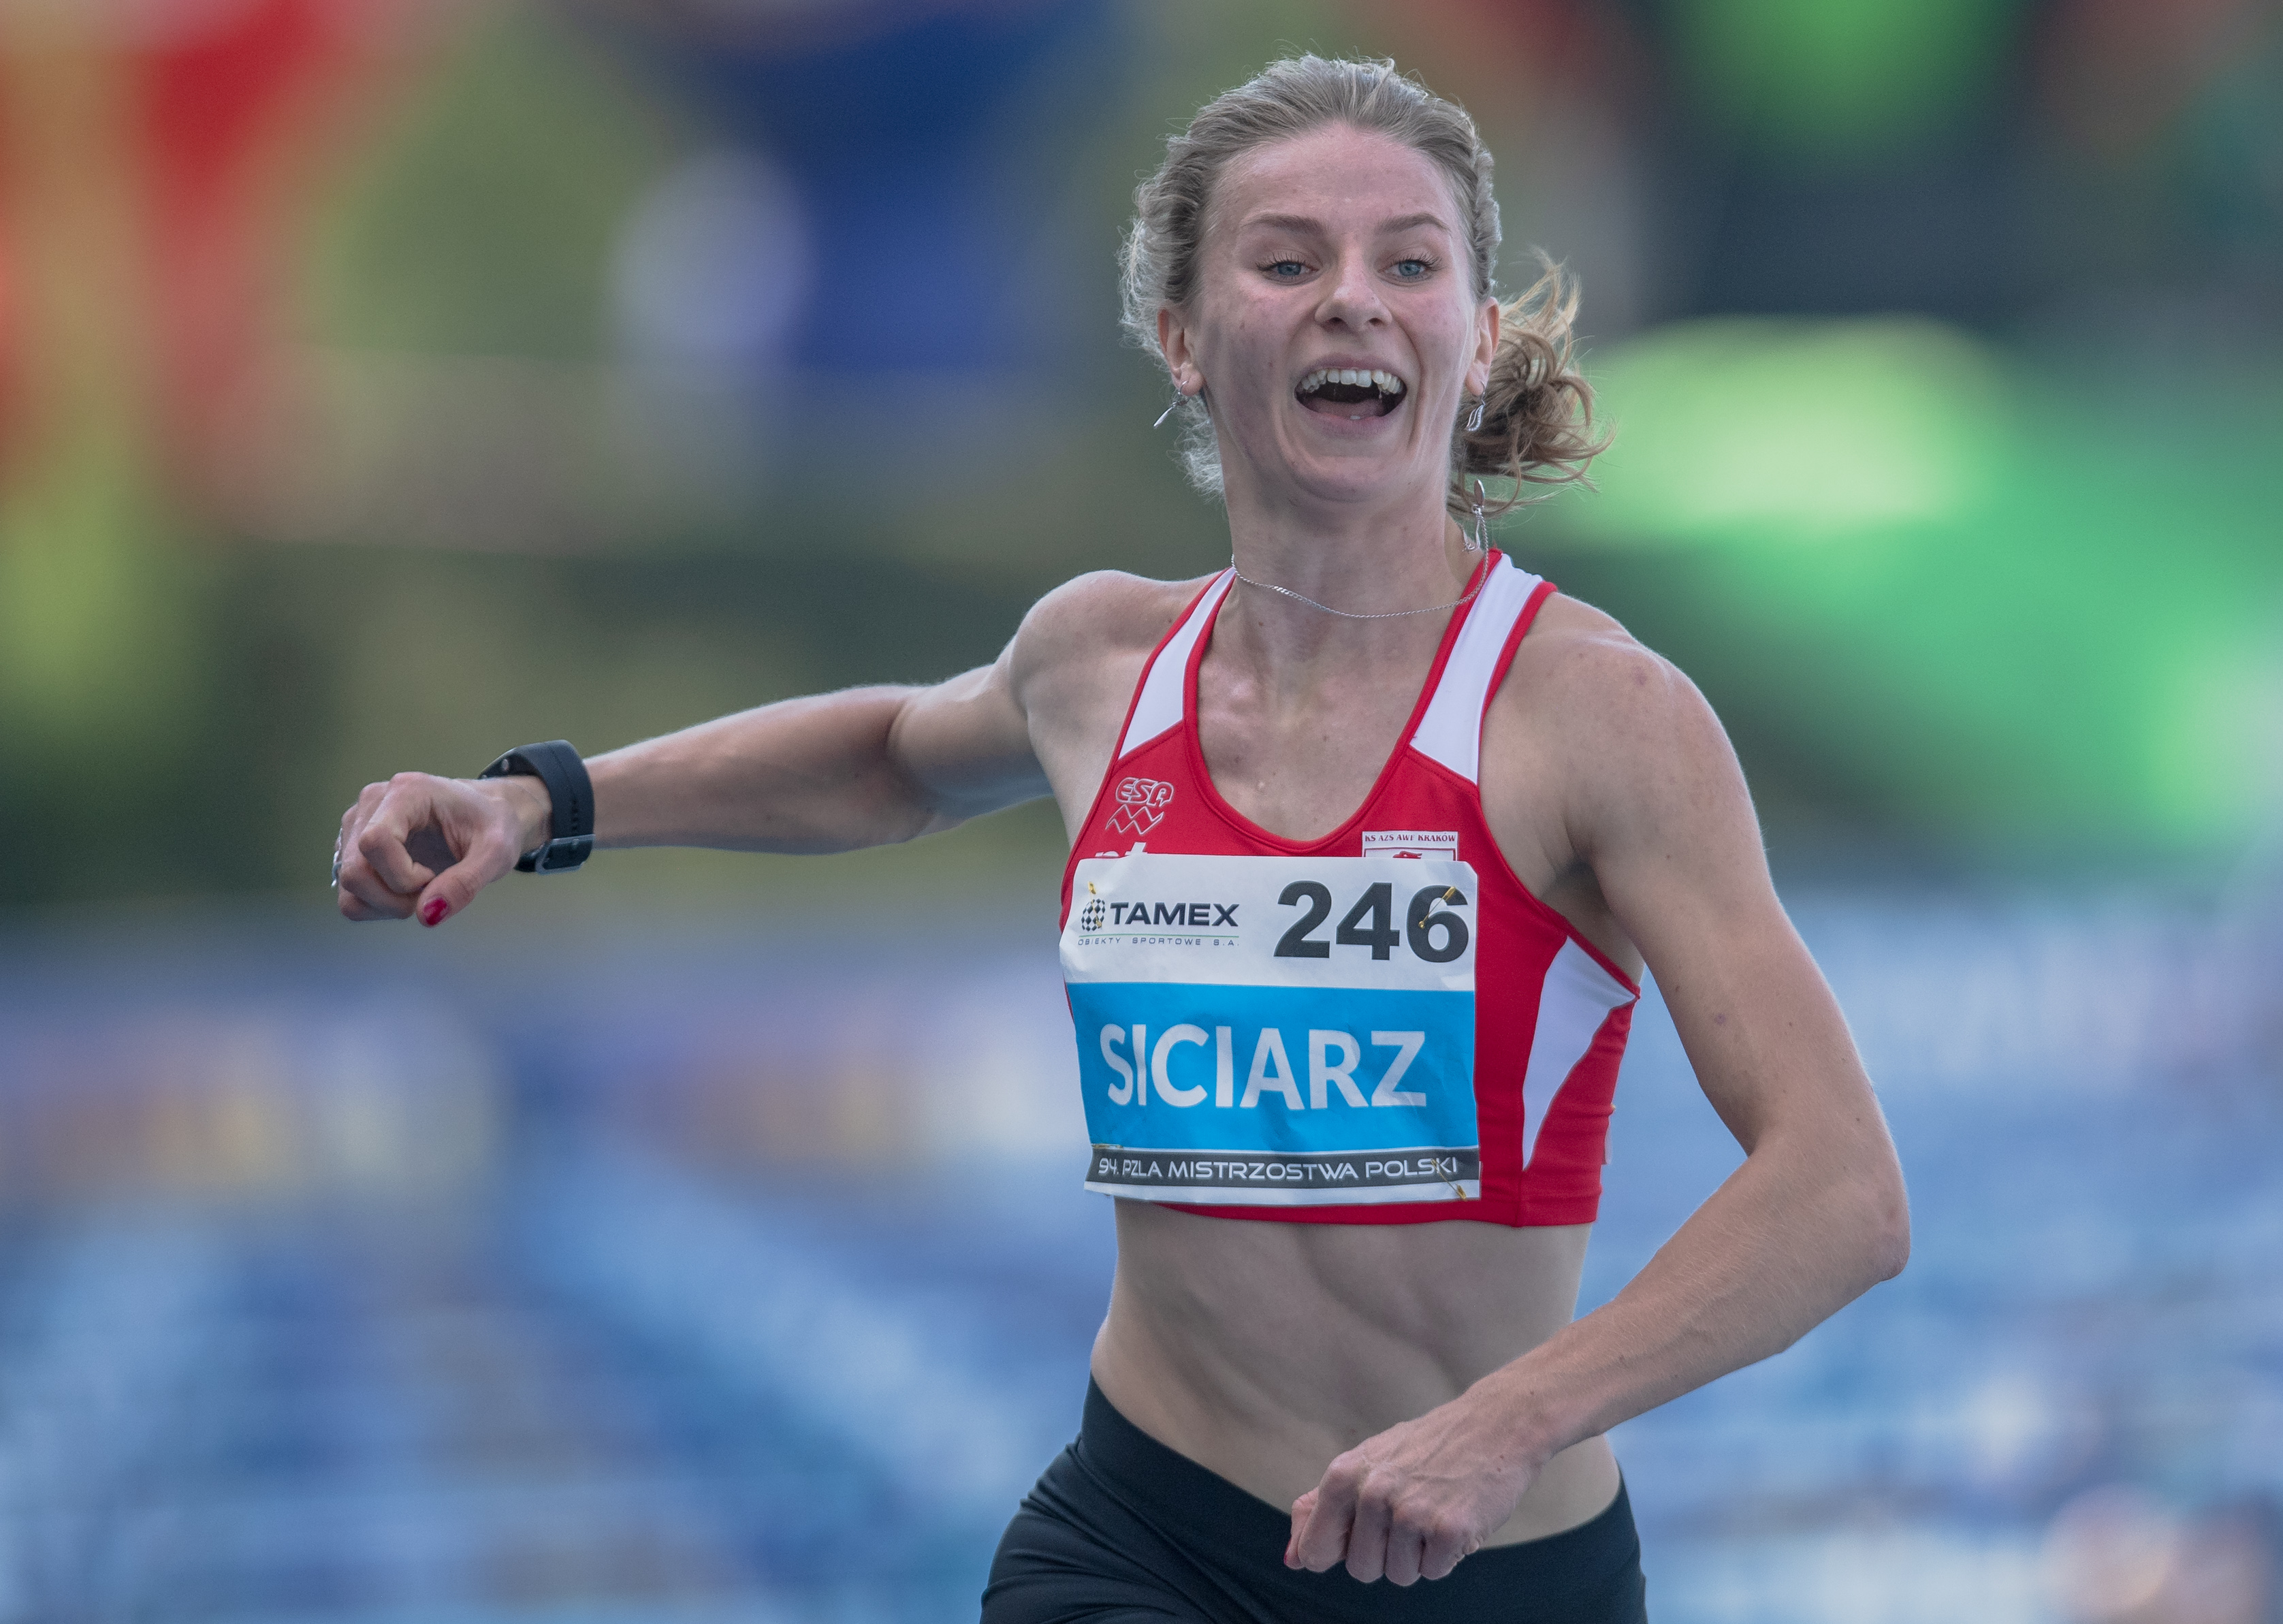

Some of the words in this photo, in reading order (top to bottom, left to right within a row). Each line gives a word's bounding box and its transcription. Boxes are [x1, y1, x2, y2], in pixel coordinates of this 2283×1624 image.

[1418, 833, 1456, 842] KRAKÓW
[1110, 902, 1240, 927] TAMEX
[1273, 880, 1469, 964] 246
[1078, 937, 1121, 946] OBIEKTY
[1132, 937, 1202, 946] SPORTOWE
[1100, 1023, 1426, 1110] SICIARZ
[1098, 1158, 1119, 1175] 94.
[1122, 1159, 1163, 1177] PZLA
[1168, 1160, 1359, 1181] MISTRZOSTWA
[1365, 1157, 1458, 1179] POLSKI
